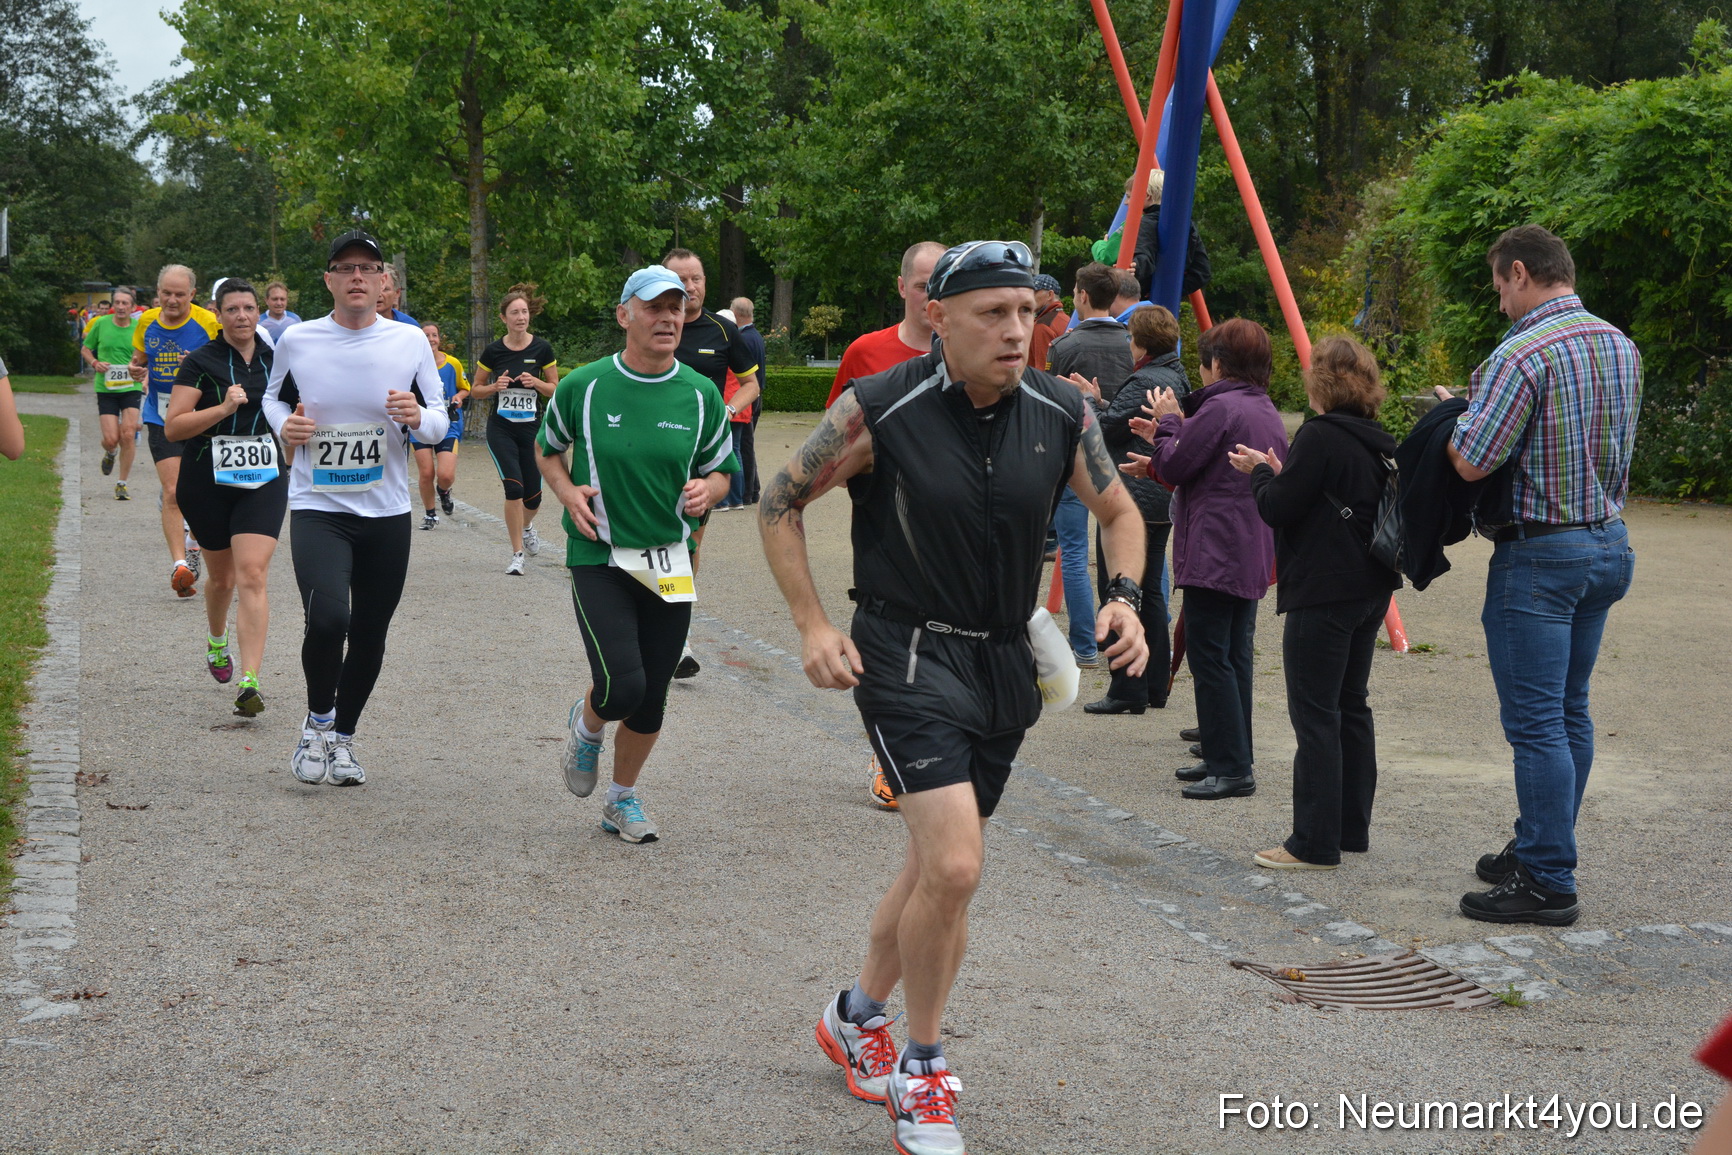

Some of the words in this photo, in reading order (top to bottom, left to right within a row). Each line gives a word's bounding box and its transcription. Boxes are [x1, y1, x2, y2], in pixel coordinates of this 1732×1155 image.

[110, 371, 128, 380] 281
[502, 396, 533, 410] 2448
[657, 421, 683, 430] africon
[220, 445, 272, 468] 2380
[318, 439, 381, 466] 2744
[233, 472, 262, 482] Kerstin
[328, 472, 370, 483] Thorsten
[953, 627, 990, 640] Kalenji
